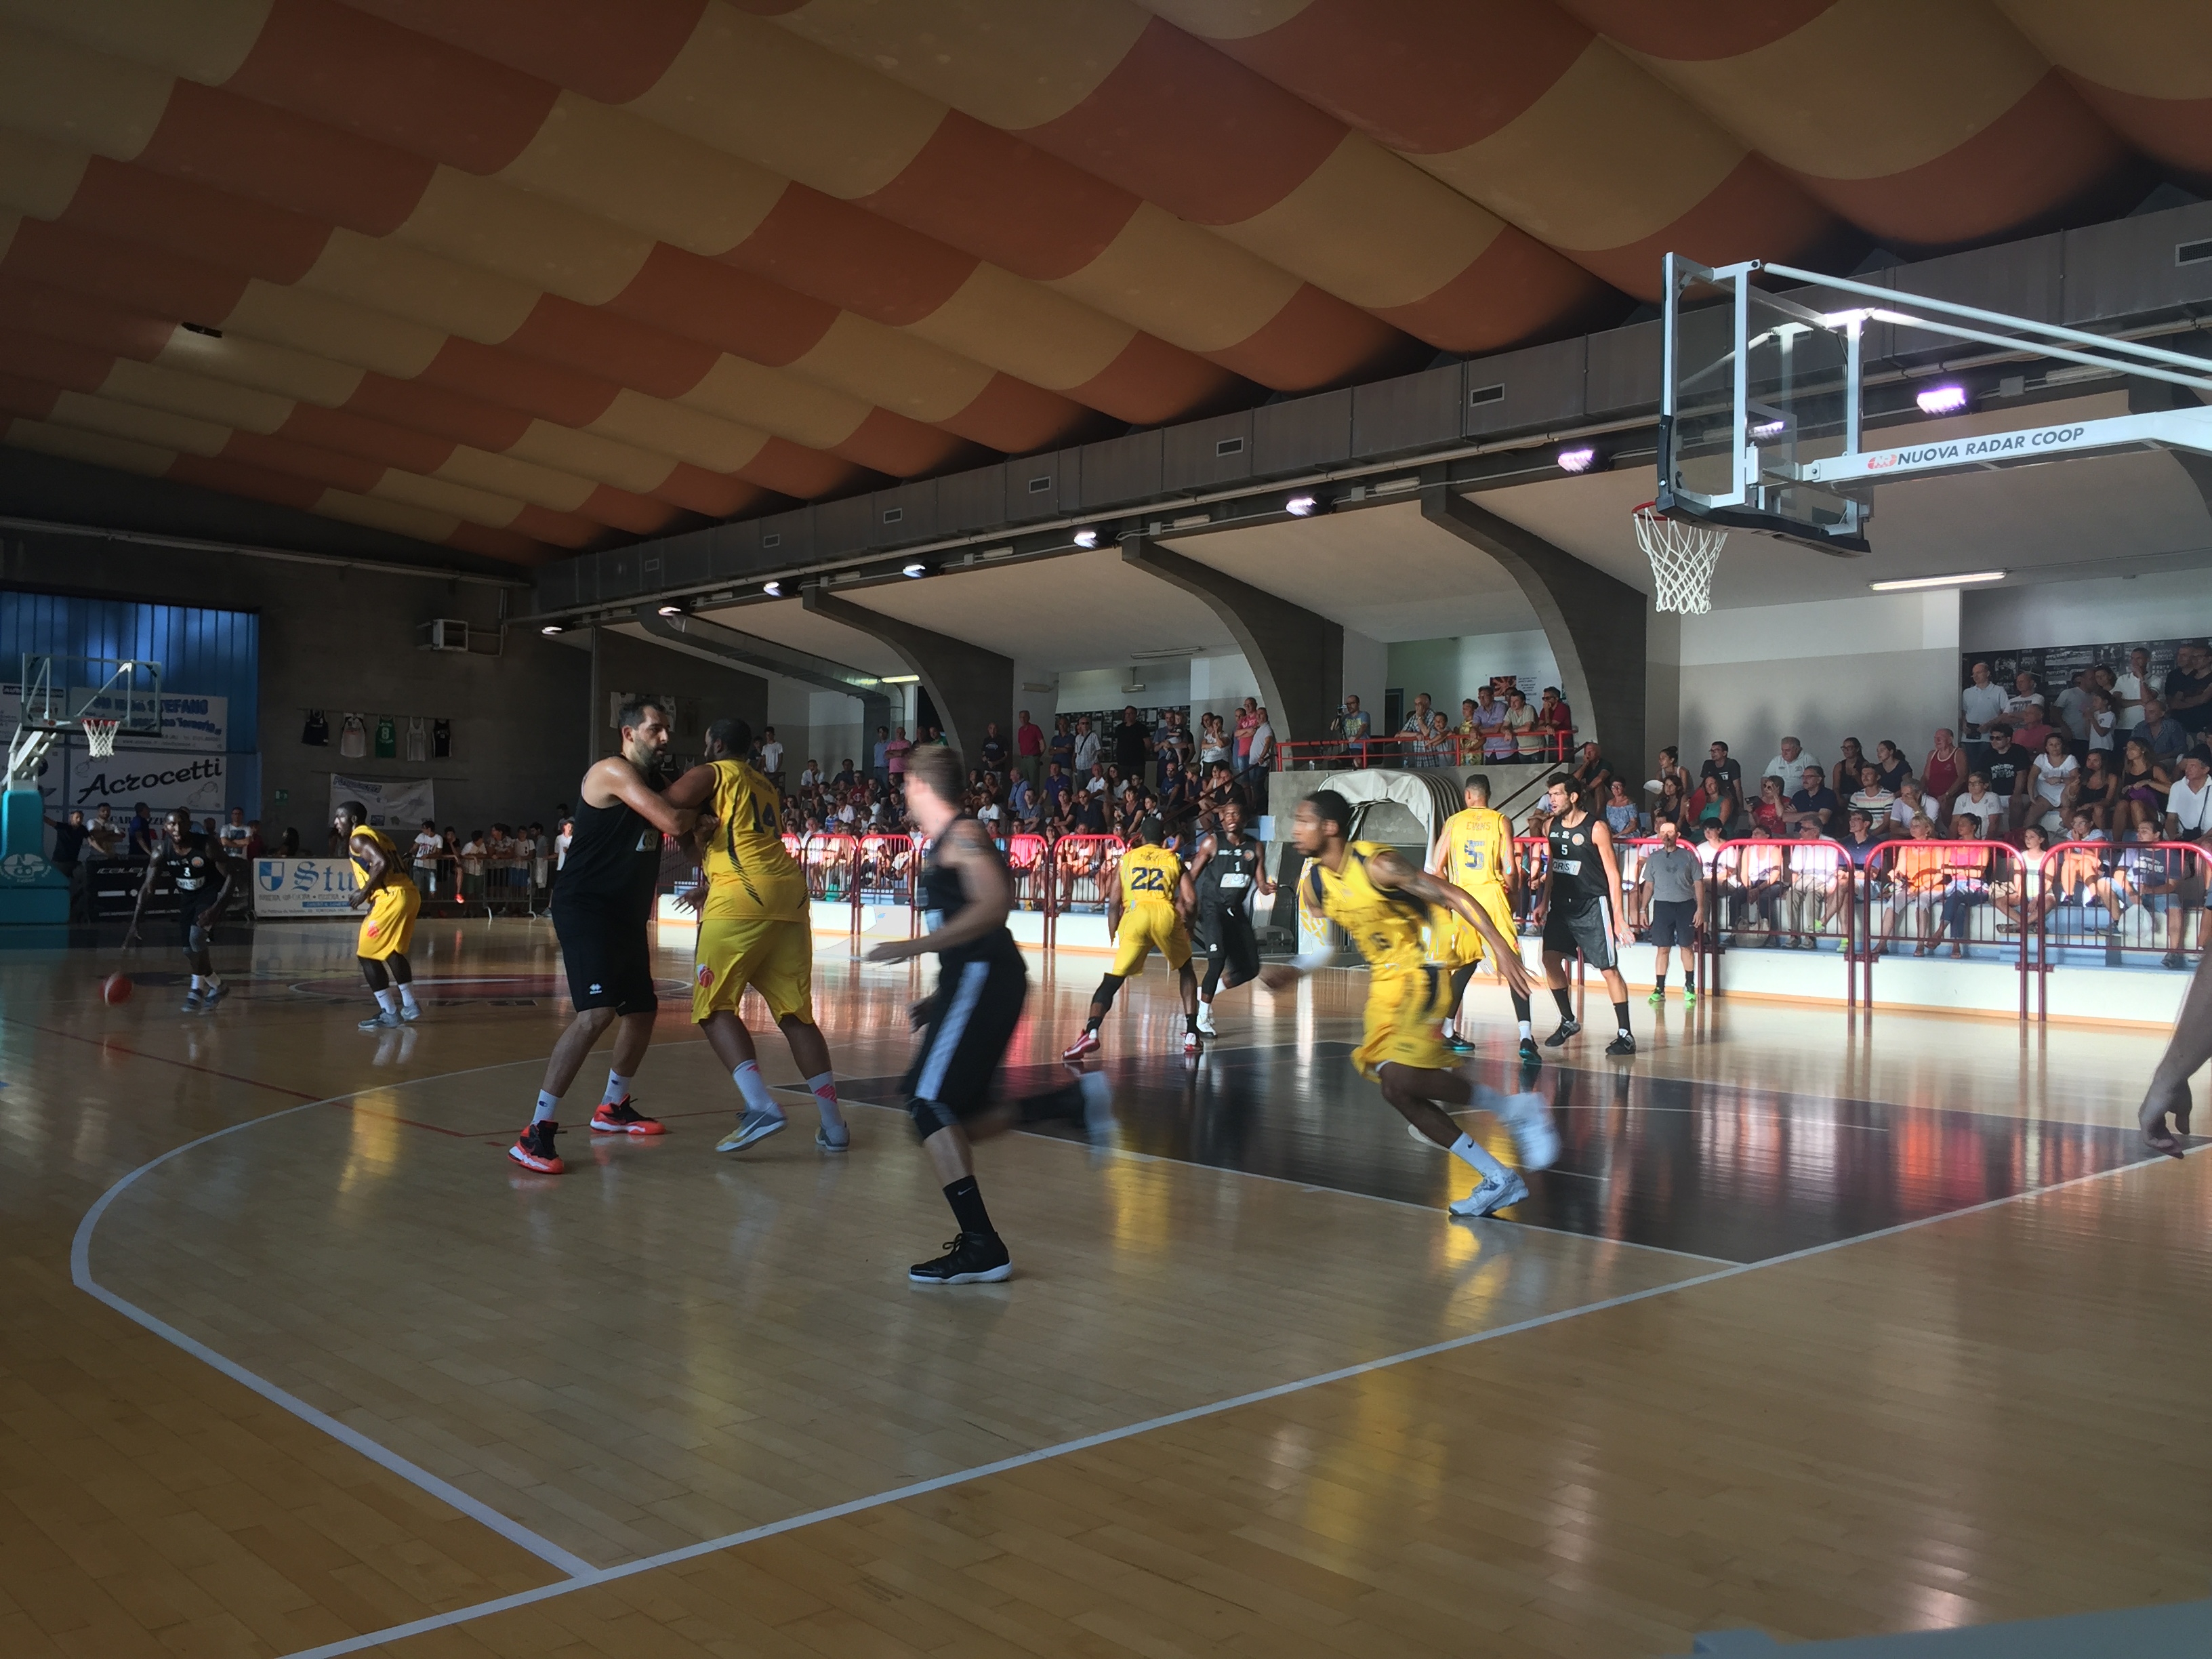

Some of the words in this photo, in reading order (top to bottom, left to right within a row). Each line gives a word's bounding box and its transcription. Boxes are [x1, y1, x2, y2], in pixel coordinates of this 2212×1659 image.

[1898, 445, 1959, 466] NUOVA
[1965, 435, 2026, 455] RADAR
[2031, 427, 2085, 446] COOP
[77, 758, 223, 804] Acrocetti
[1464, 840, 1485, 870] 5
[1561, 843, 1568, 856] 5
[183, 867, 191, 878] 3
[1131, 866, 1164, 891] 22
[1234, 861, 1241, 872] 1
